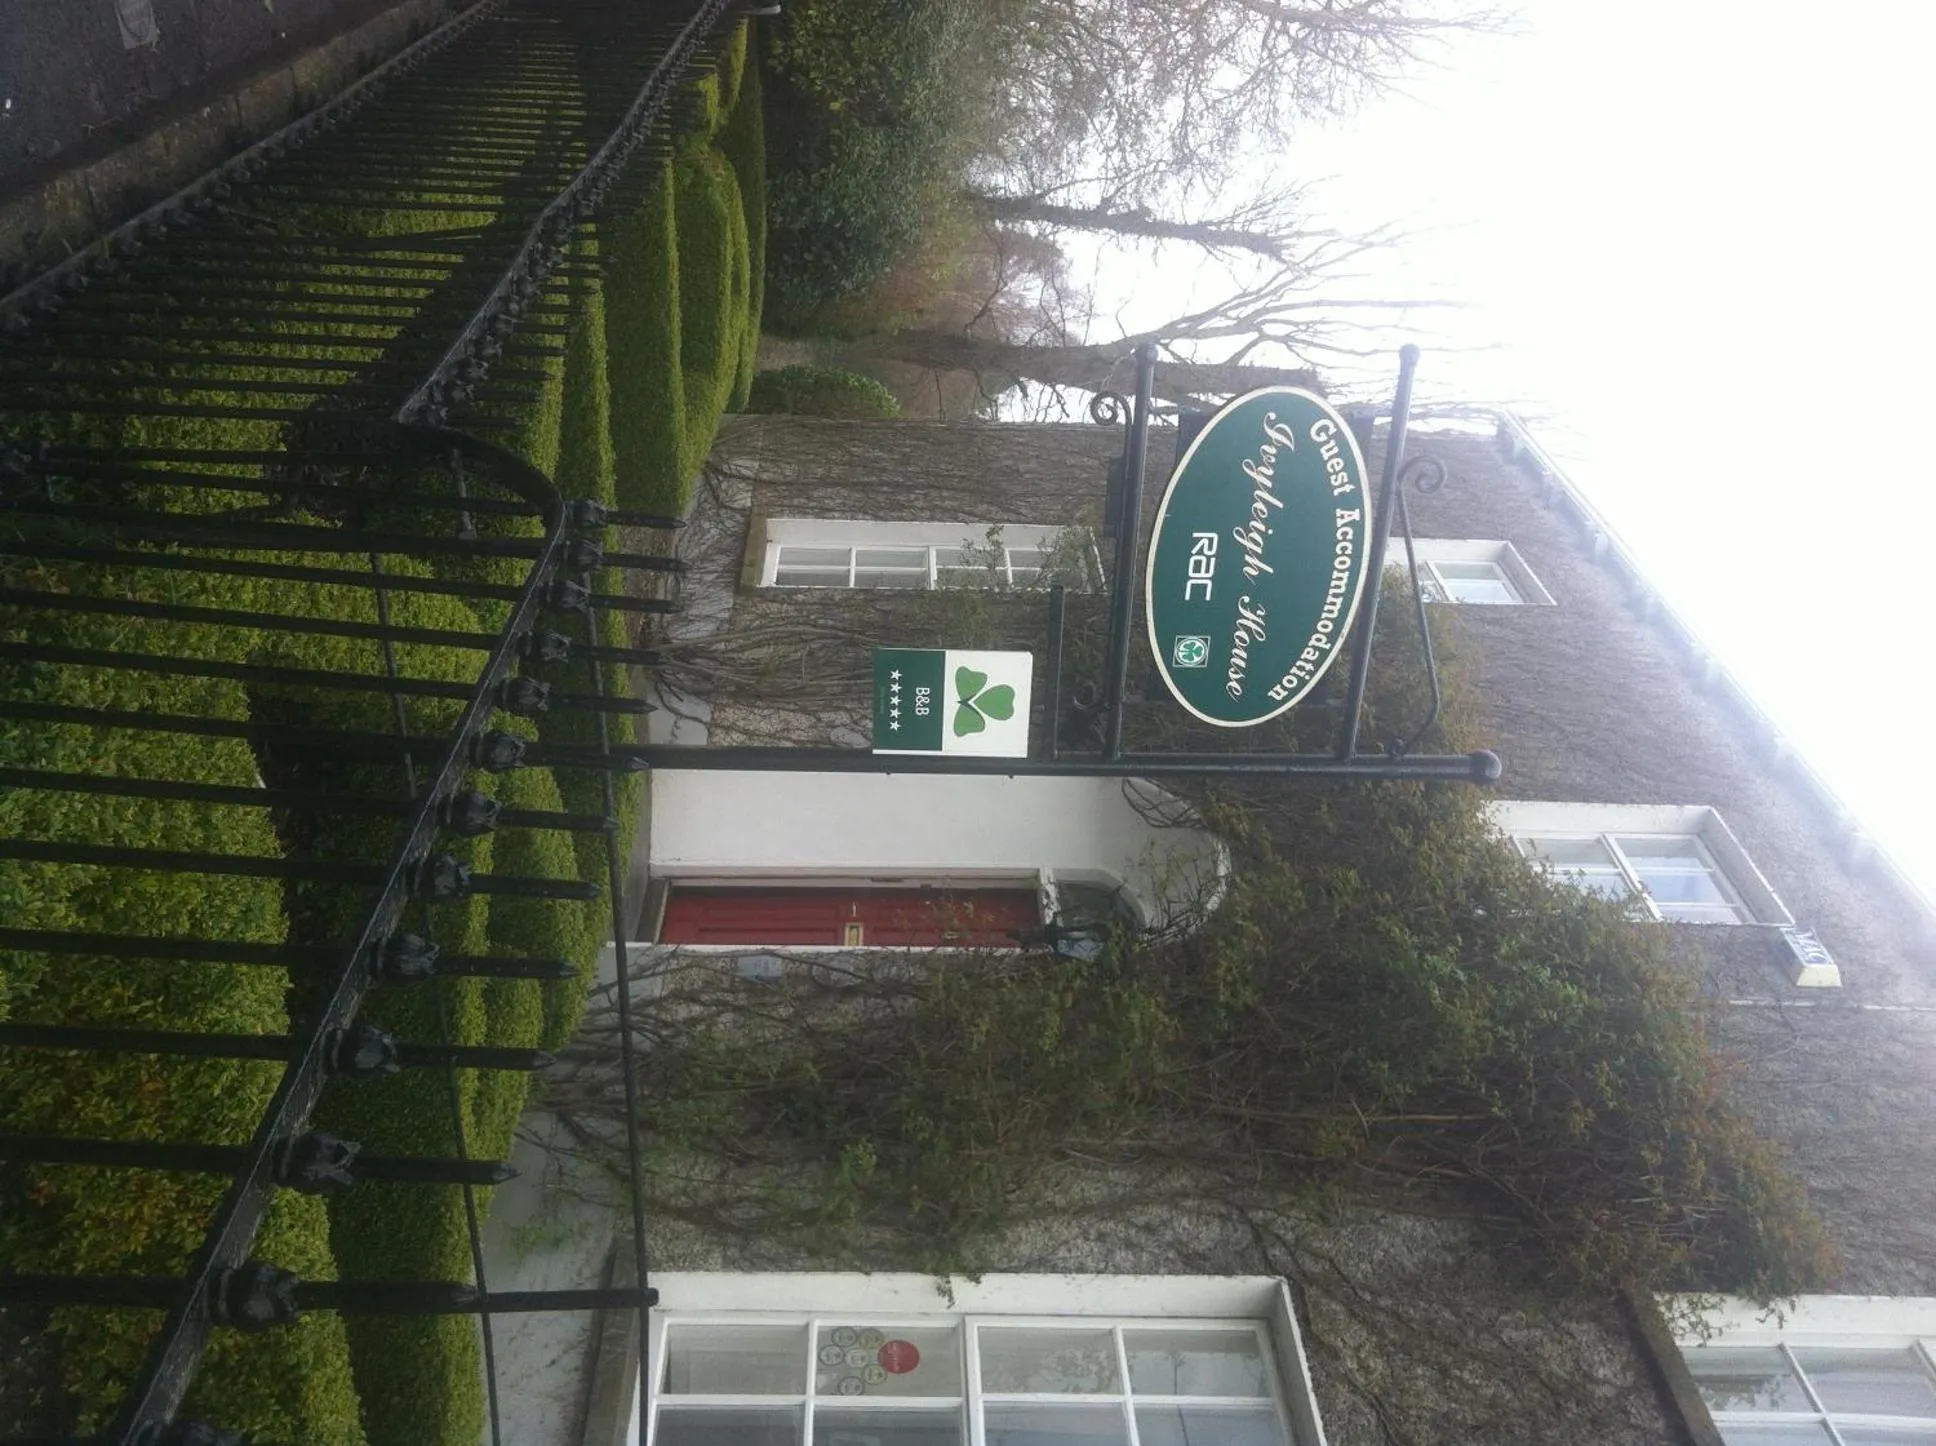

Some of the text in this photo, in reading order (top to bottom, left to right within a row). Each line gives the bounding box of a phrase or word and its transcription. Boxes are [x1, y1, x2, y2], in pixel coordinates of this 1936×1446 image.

[1225, 412, 1296, 703] Ivyleigh House
[1267, 418, 1360, 701] Guest Accommodation
[915, 686, 930, 716] B&B
